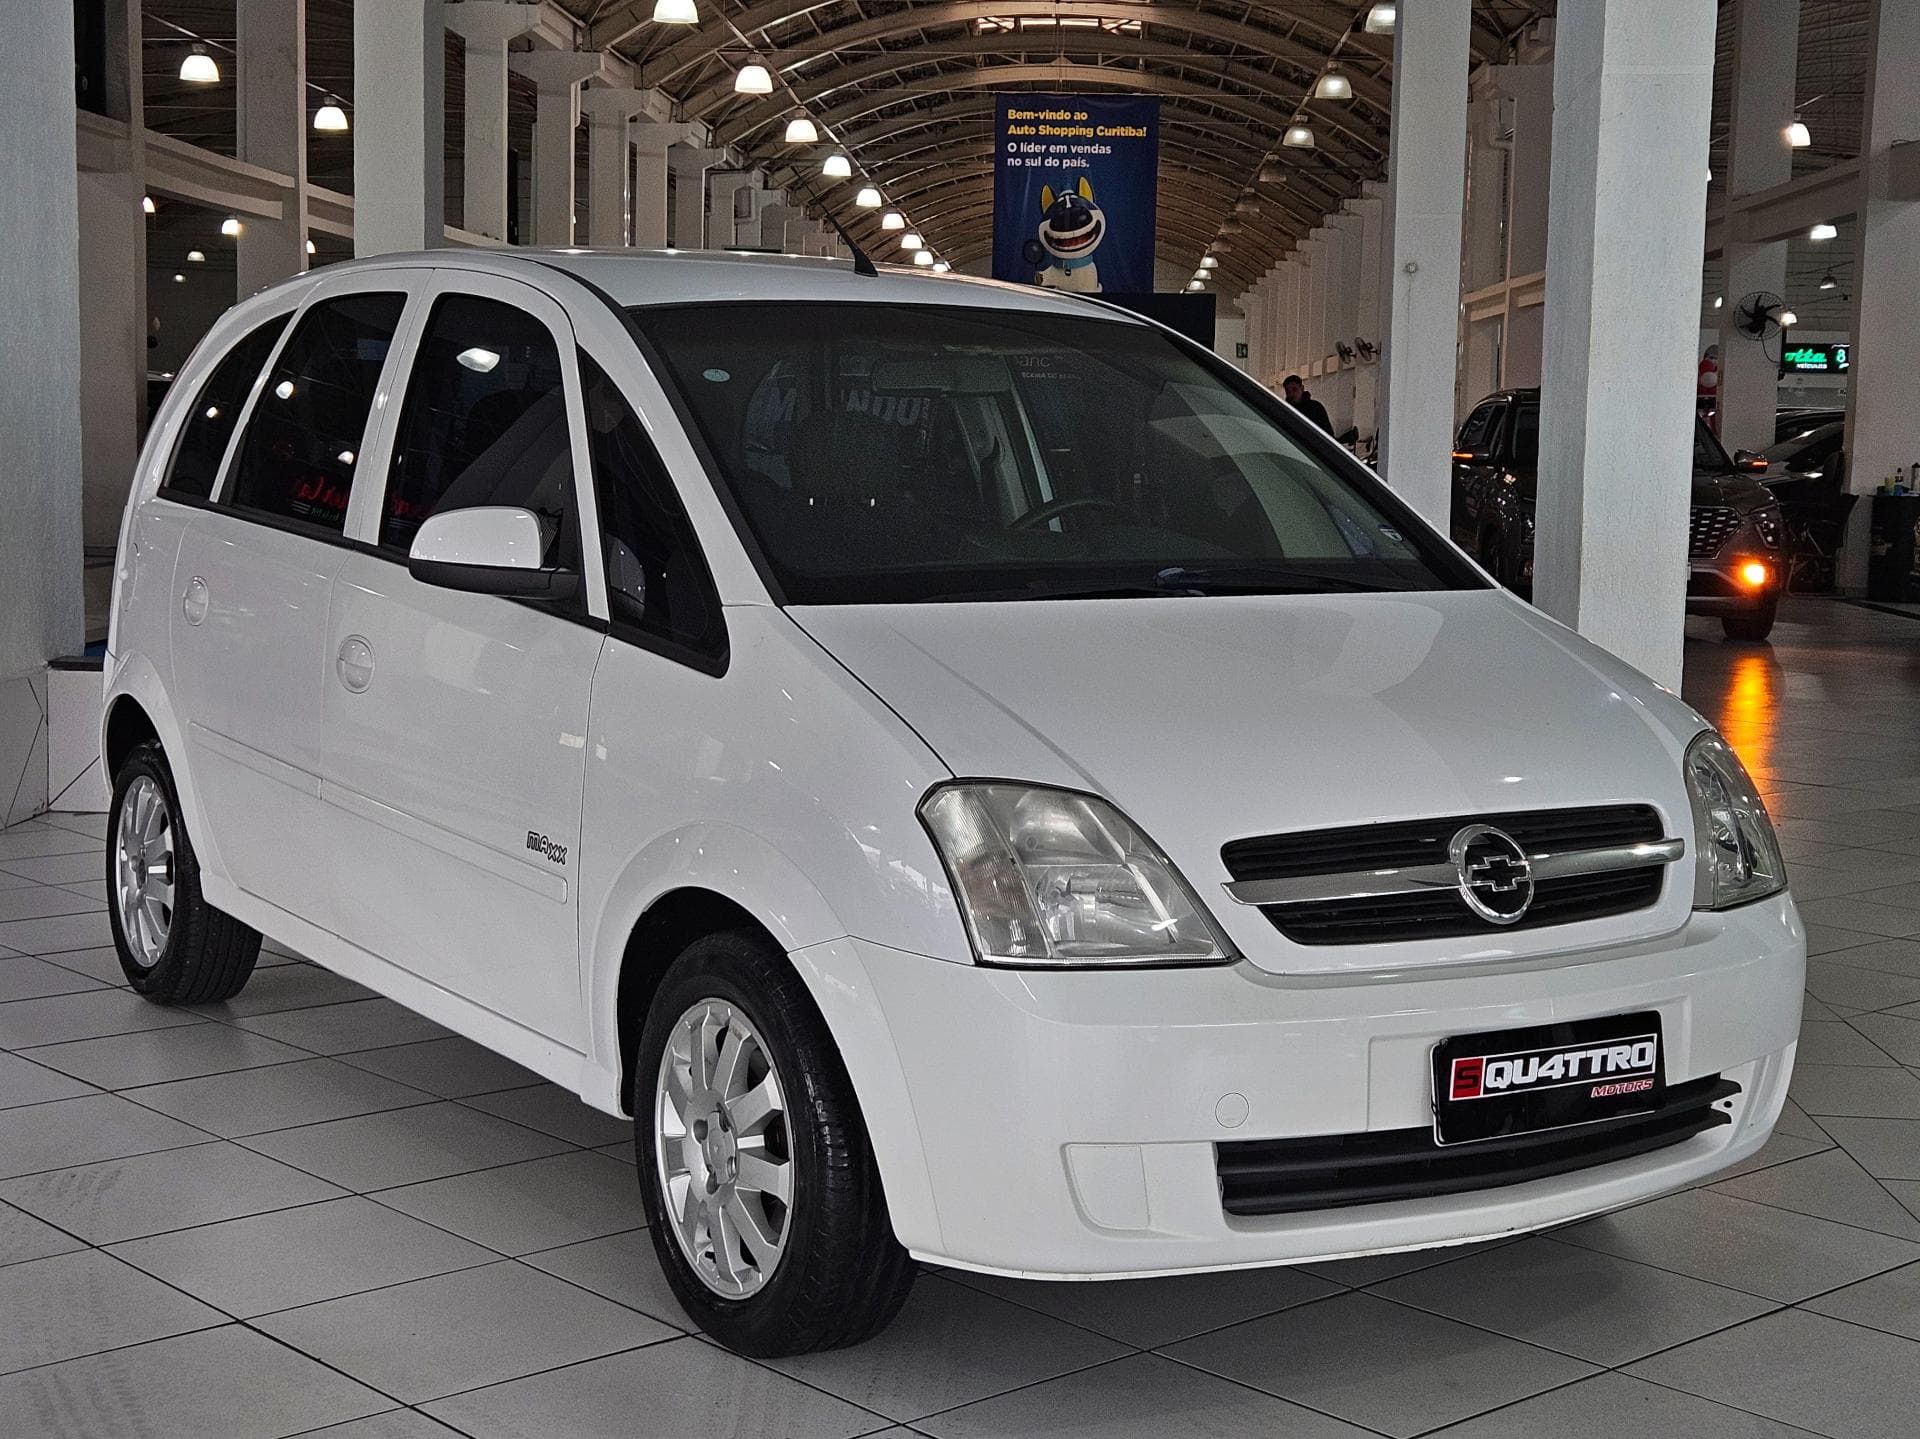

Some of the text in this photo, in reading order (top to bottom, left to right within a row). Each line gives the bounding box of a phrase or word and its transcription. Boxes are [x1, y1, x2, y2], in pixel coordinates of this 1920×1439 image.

[1007, 109, 1088, 120] Bem-vindo ao
[1007, 125, 1147, 137] Auto Shopping Curitiba!
[1007, 142, 1112, 154] O líder em vendas
[1007, 157, 1090, 169] no sul do país.
[1591, 1079, 1654, 1098] MOTORS
